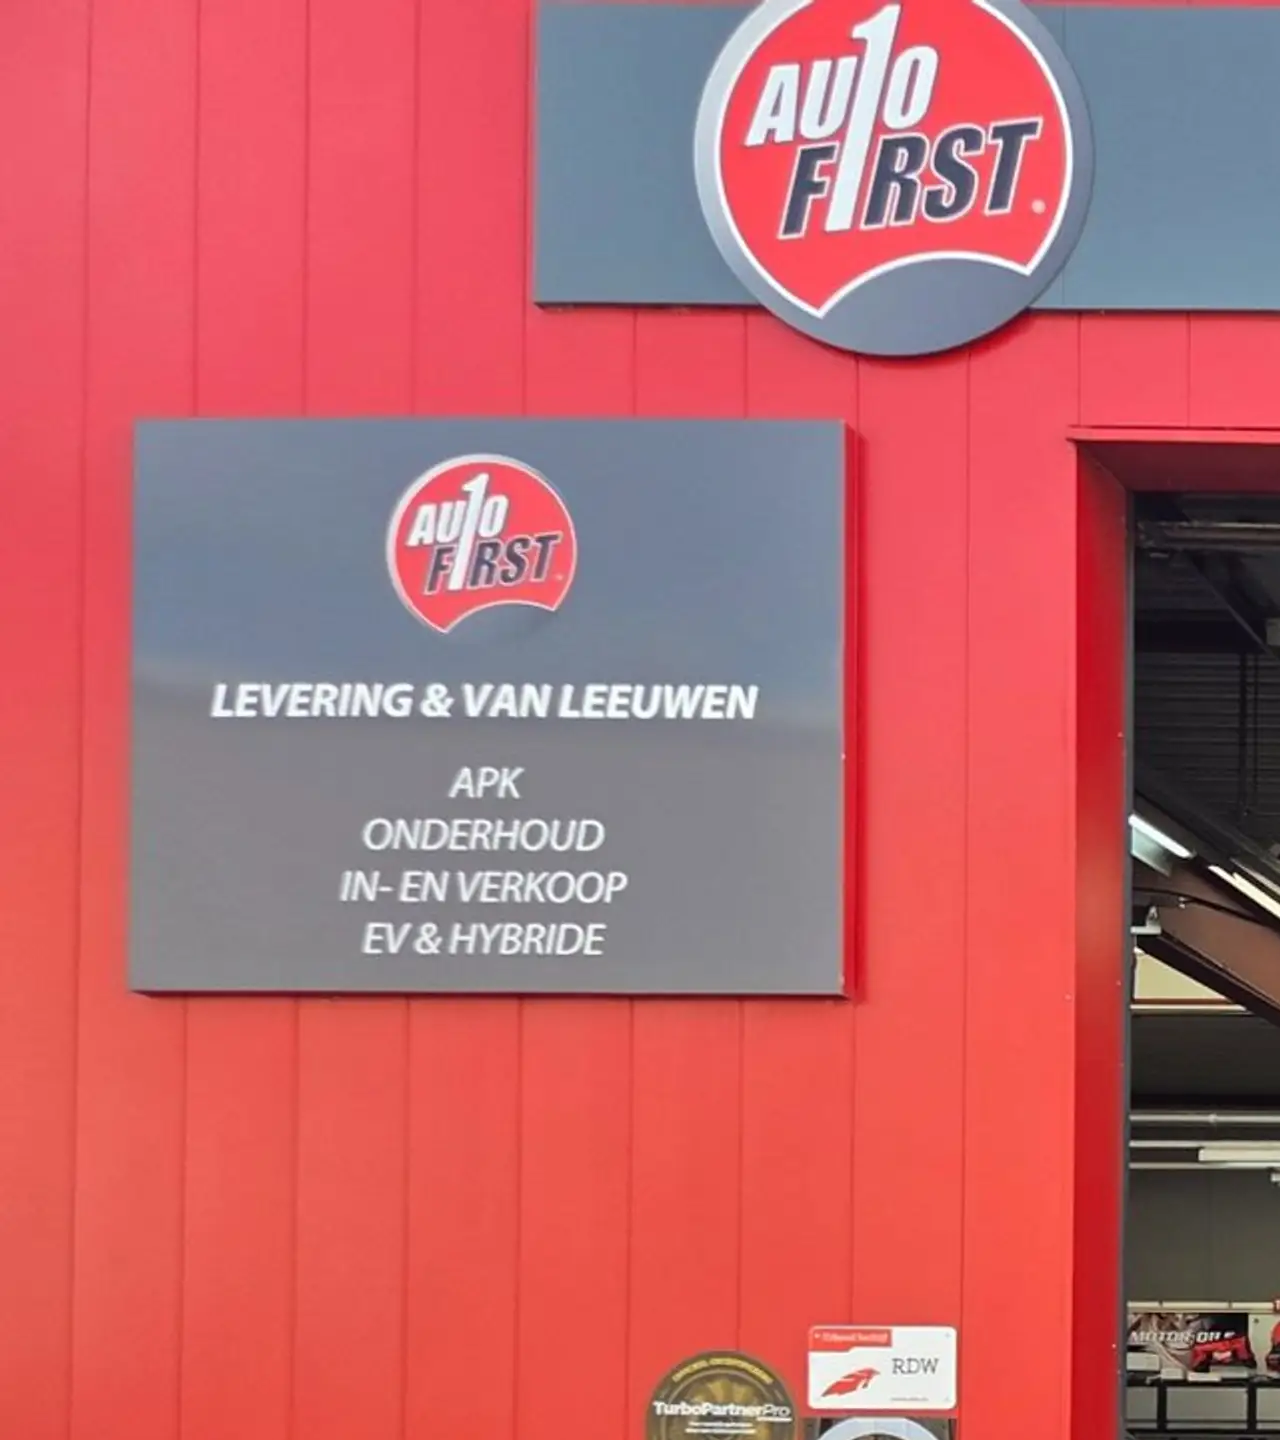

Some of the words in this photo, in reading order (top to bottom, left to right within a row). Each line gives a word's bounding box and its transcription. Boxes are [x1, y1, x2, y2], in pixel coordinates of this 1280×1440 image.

[211, 682, 413, 718] LEVERING
[420, 683, 455, 718] &
[462, 683, 552, 718] VAN
[558, 684, 759, 720] LEEUWEN
[448, 766, 525, 799] APK
[361, 817, 606, 851] ONDERHOUD
[339, 870, 393, 902] IN-
[400, 870, 449, 902] EN
[458, 870, 628, 902] VERKOOP
[361, 922, 411, 954] EV
[413, 922, 442, 954] &
[448, 922, 607, 955] HYBRIDE
[892, 1357, 939, 1375] RDW
[652, 1401, 792, 1418] TurboPartnerPro
